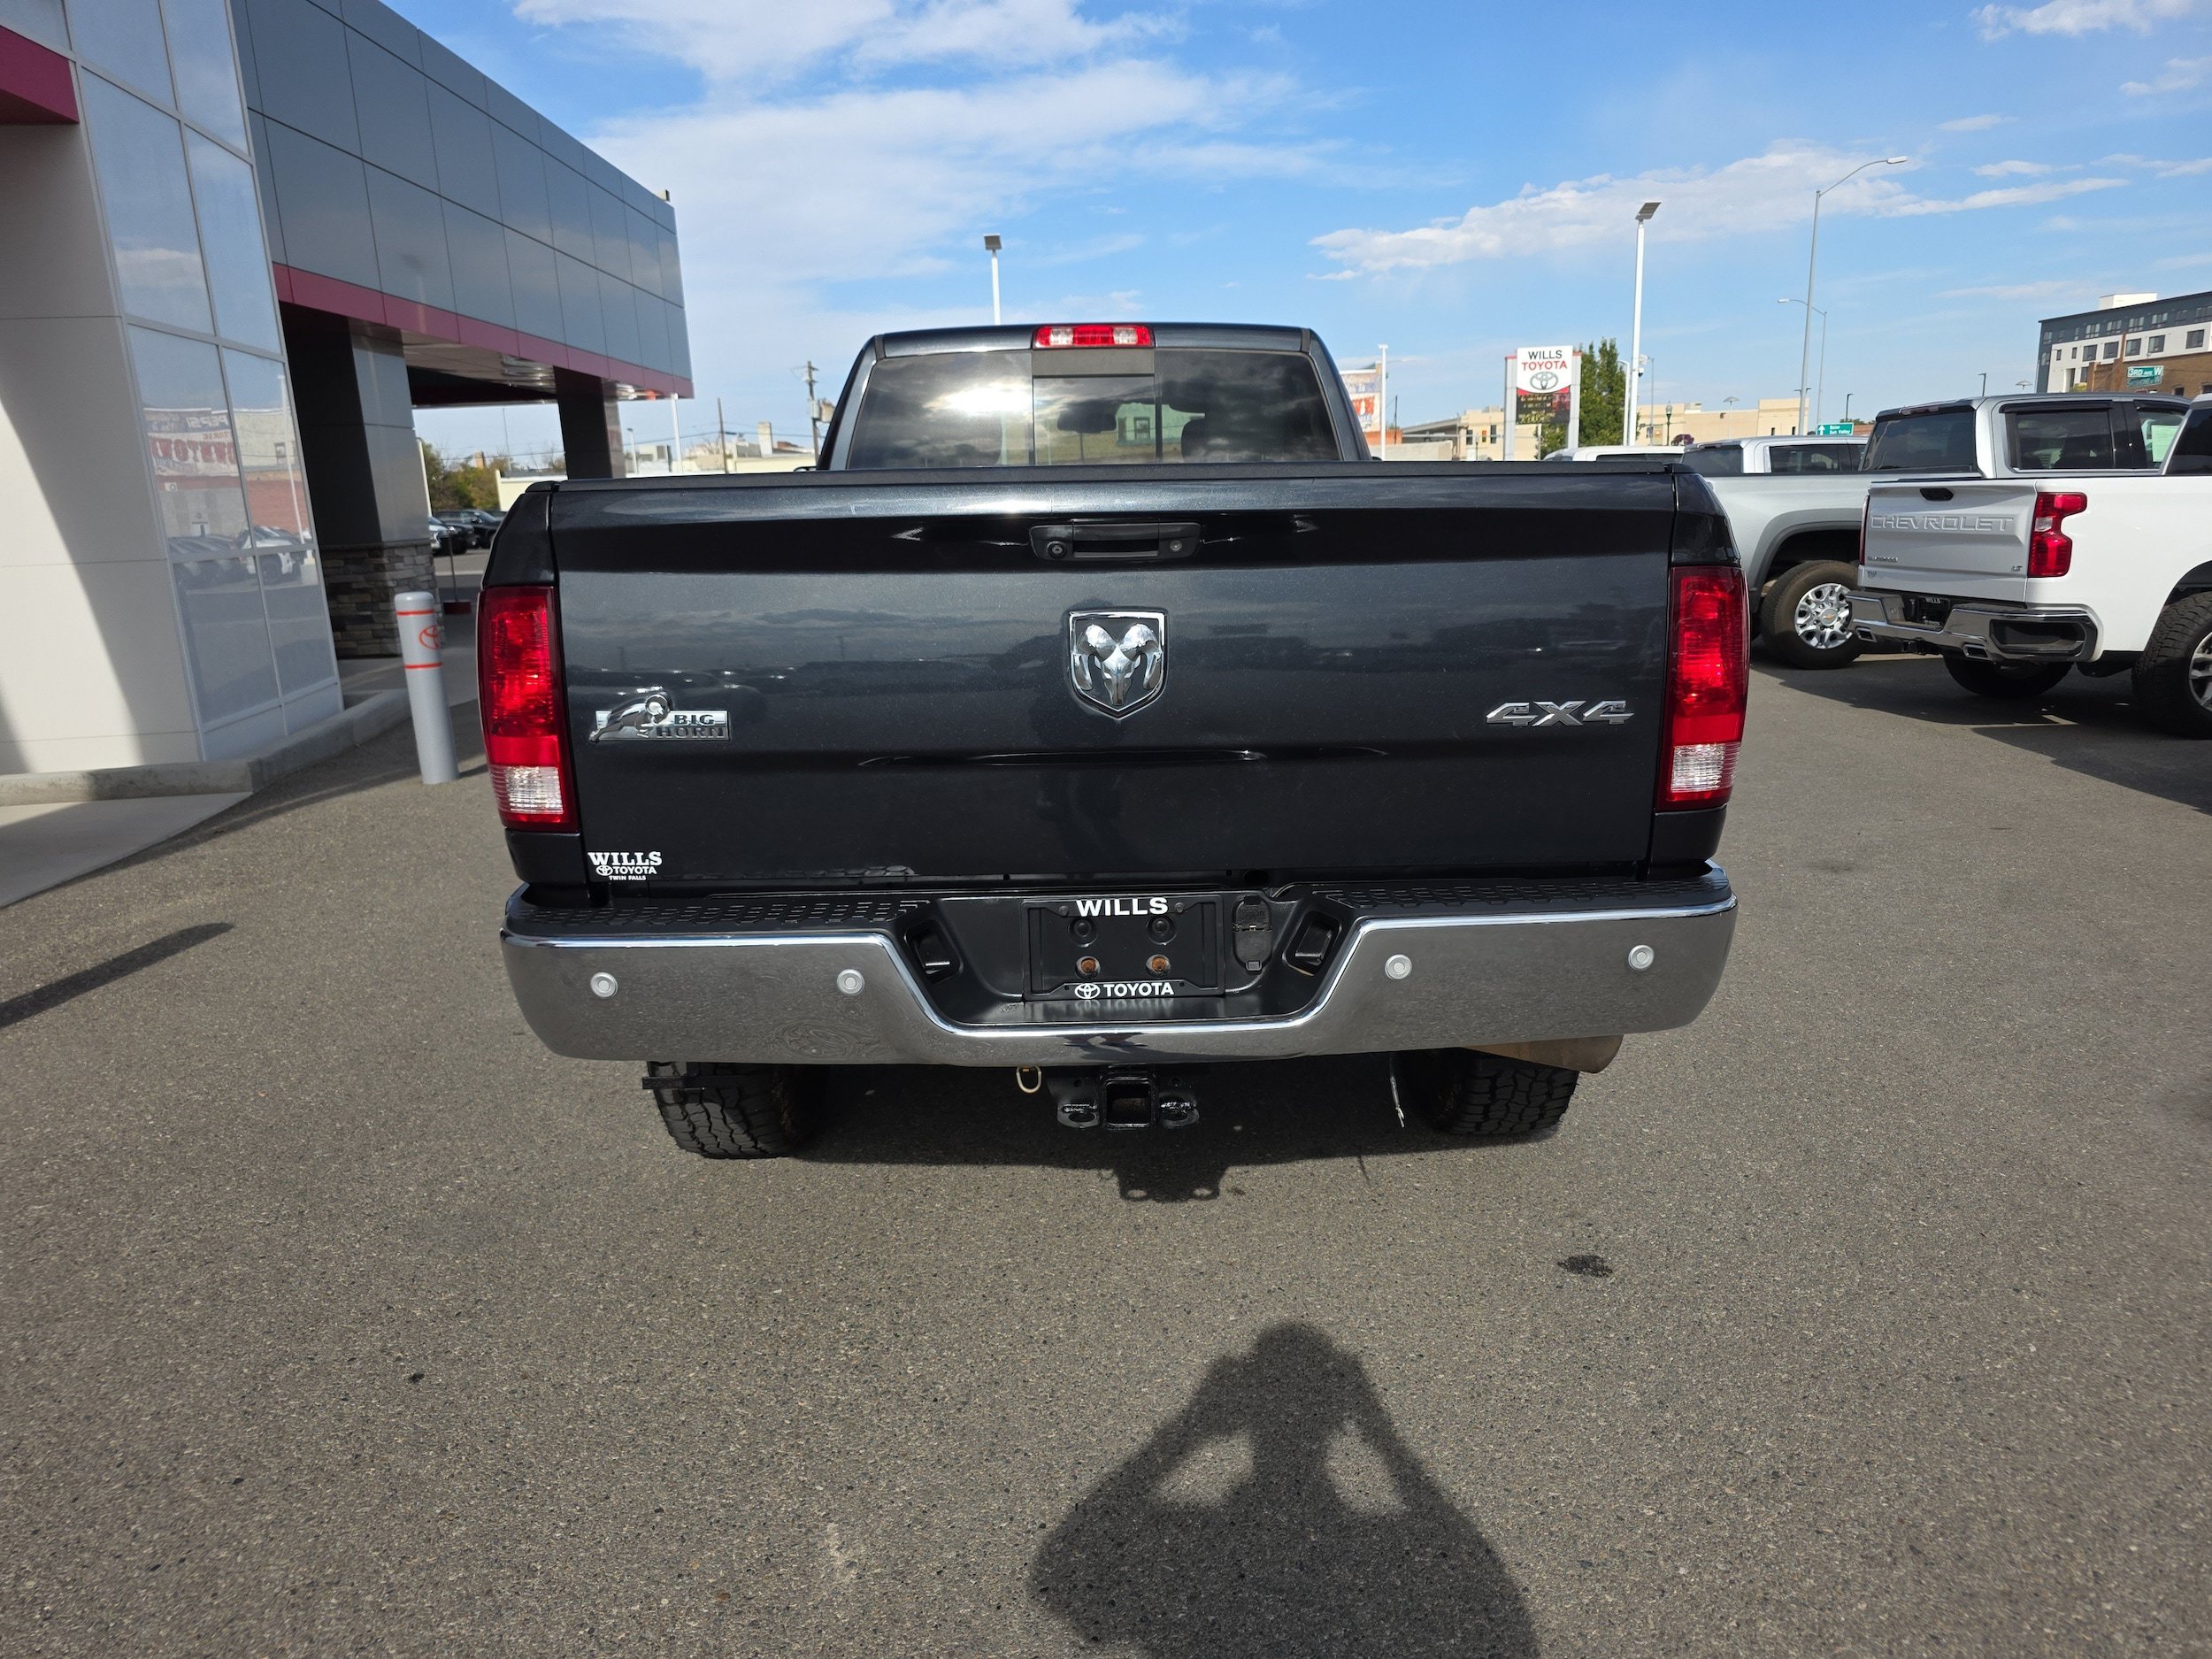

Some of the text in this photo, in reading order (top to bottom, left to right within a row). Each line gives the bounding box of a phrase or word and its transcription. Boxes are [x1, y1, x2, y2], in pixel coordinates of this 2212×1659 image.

[1528, 349, 1563, 360] WILLS
[1521, 360, 1568, 371] TOYOTA
[1870, 514, 2016, 533] CHEVROLET
[673, 714, 716, 726] BIG
[655, 726, 726, 739] HORN
[588, 851, 663, 867] WILLS
[612, 866, 657, 875] TOYOTA
[1076, 897, 1169, 917] WILLS
[1103, 982, 1175, 997] TOYOTA
